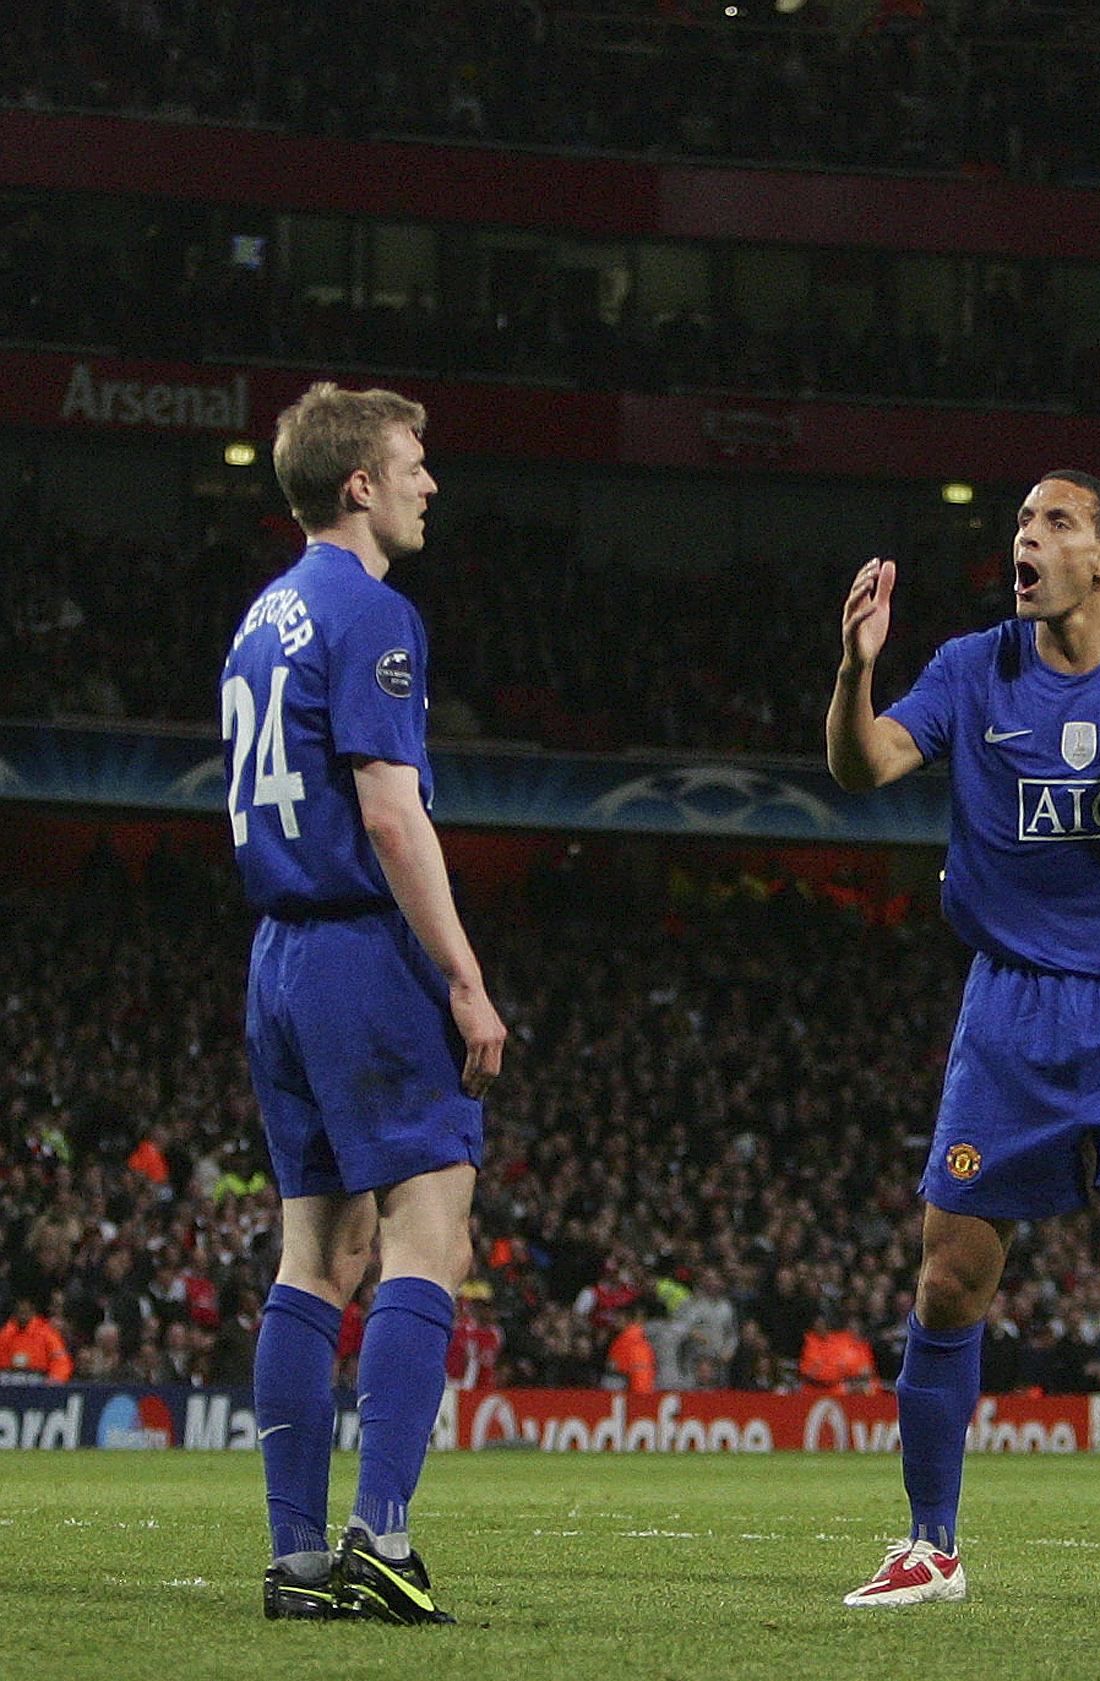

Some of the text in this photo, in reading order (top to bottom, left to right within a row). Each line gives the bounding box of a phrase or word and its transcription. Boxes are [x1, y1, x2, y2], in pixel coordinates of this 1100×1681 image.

[60, 363, 249, 430] Arsenal
[221, 666, 305, 847] 24
[521, 1394, 774, 1452] vodafone
